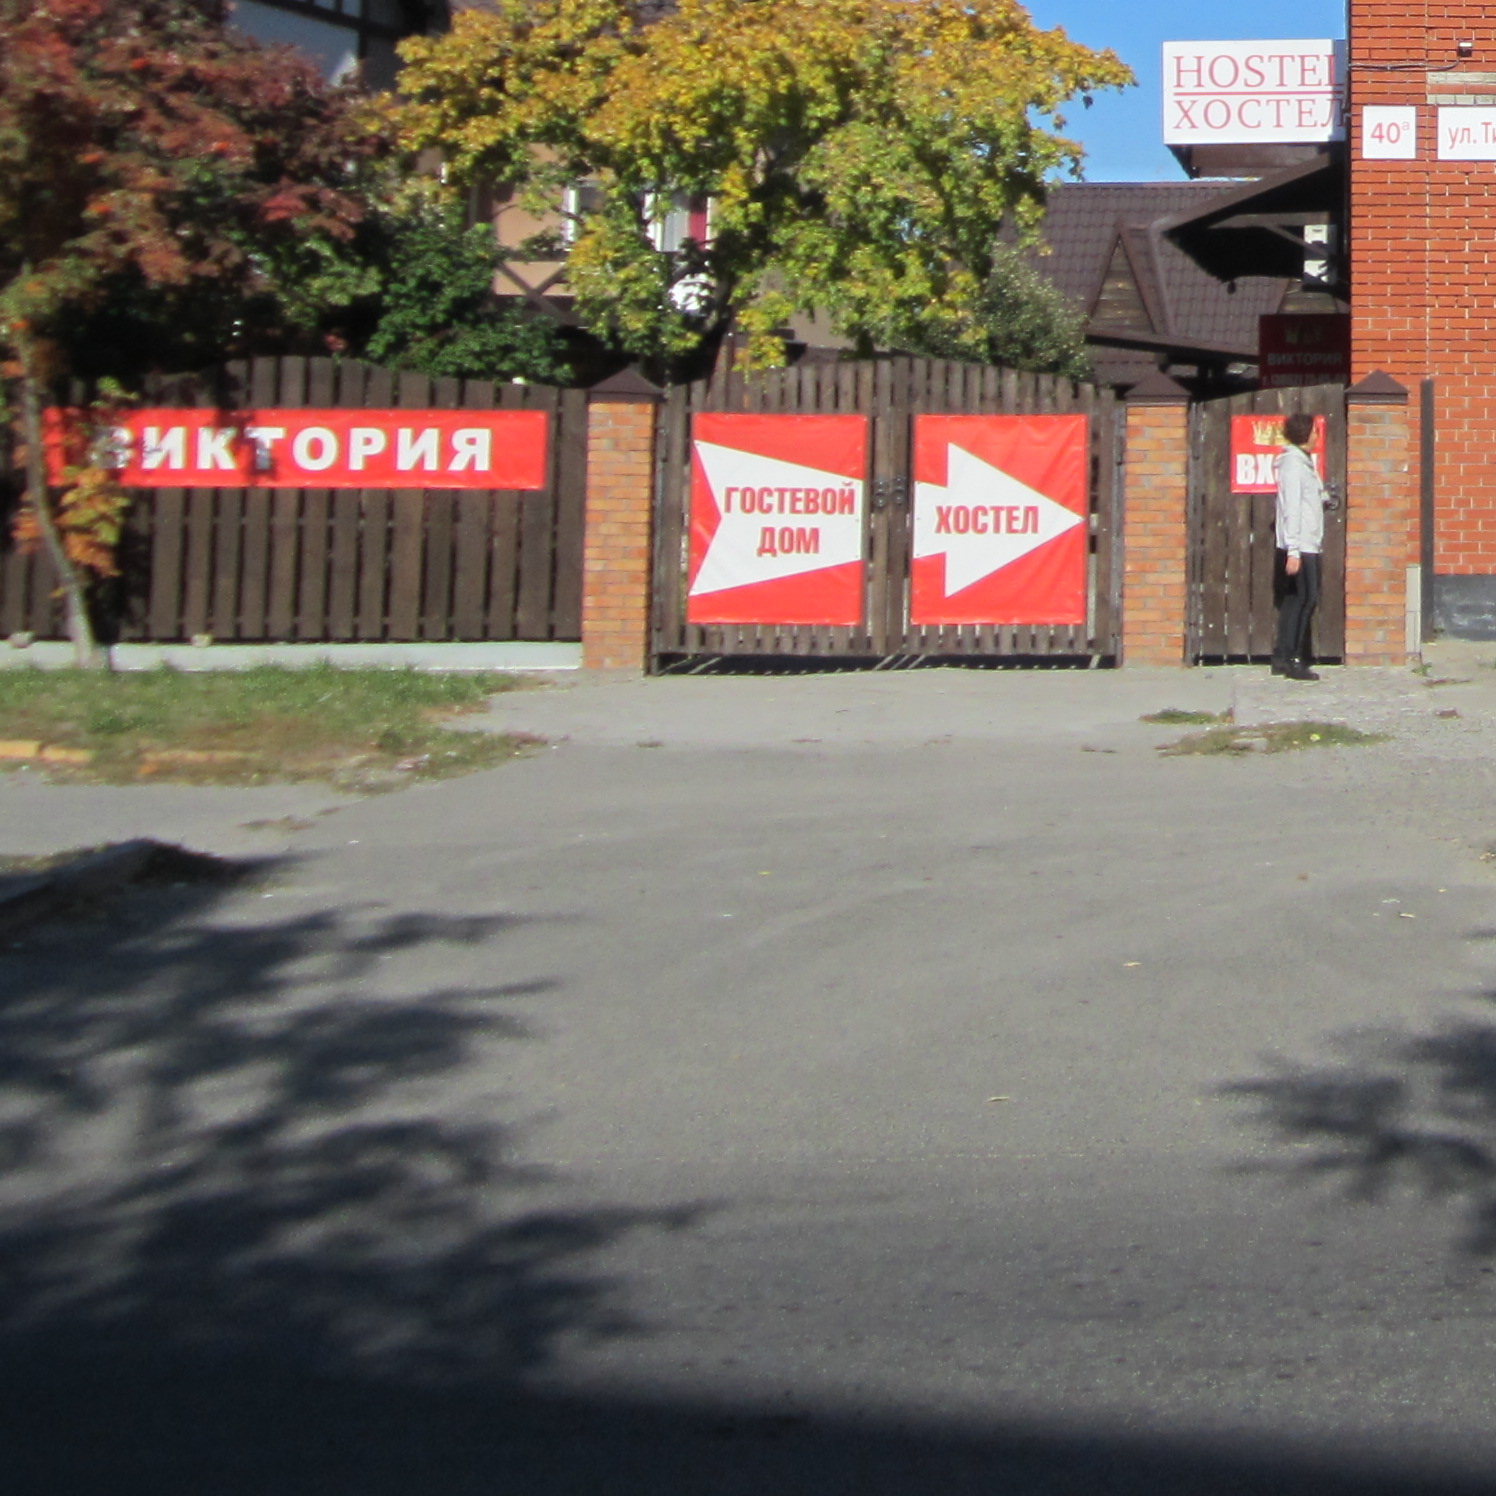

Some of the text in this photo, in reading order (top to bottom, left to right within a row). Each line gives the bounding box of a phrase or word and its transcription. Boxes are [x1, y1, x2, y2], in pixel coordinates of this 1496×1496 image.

[1173, 54, 1345, 88] HOSTEL
[1173, 98, 1346, 130] ХОСТЕЛ
[1448, 126, 1478, 150] ул.
[1267, 352, 1343, 366] ВИКТОРИЯ
[1236, 453, 1318, 485] ВХ
[723, 481, 856, 516] ГОСТЕВОЙ
[934, 505, 1039, 535] ХОСТЕЛ
[756, 526, 820, 558] ДОМ
